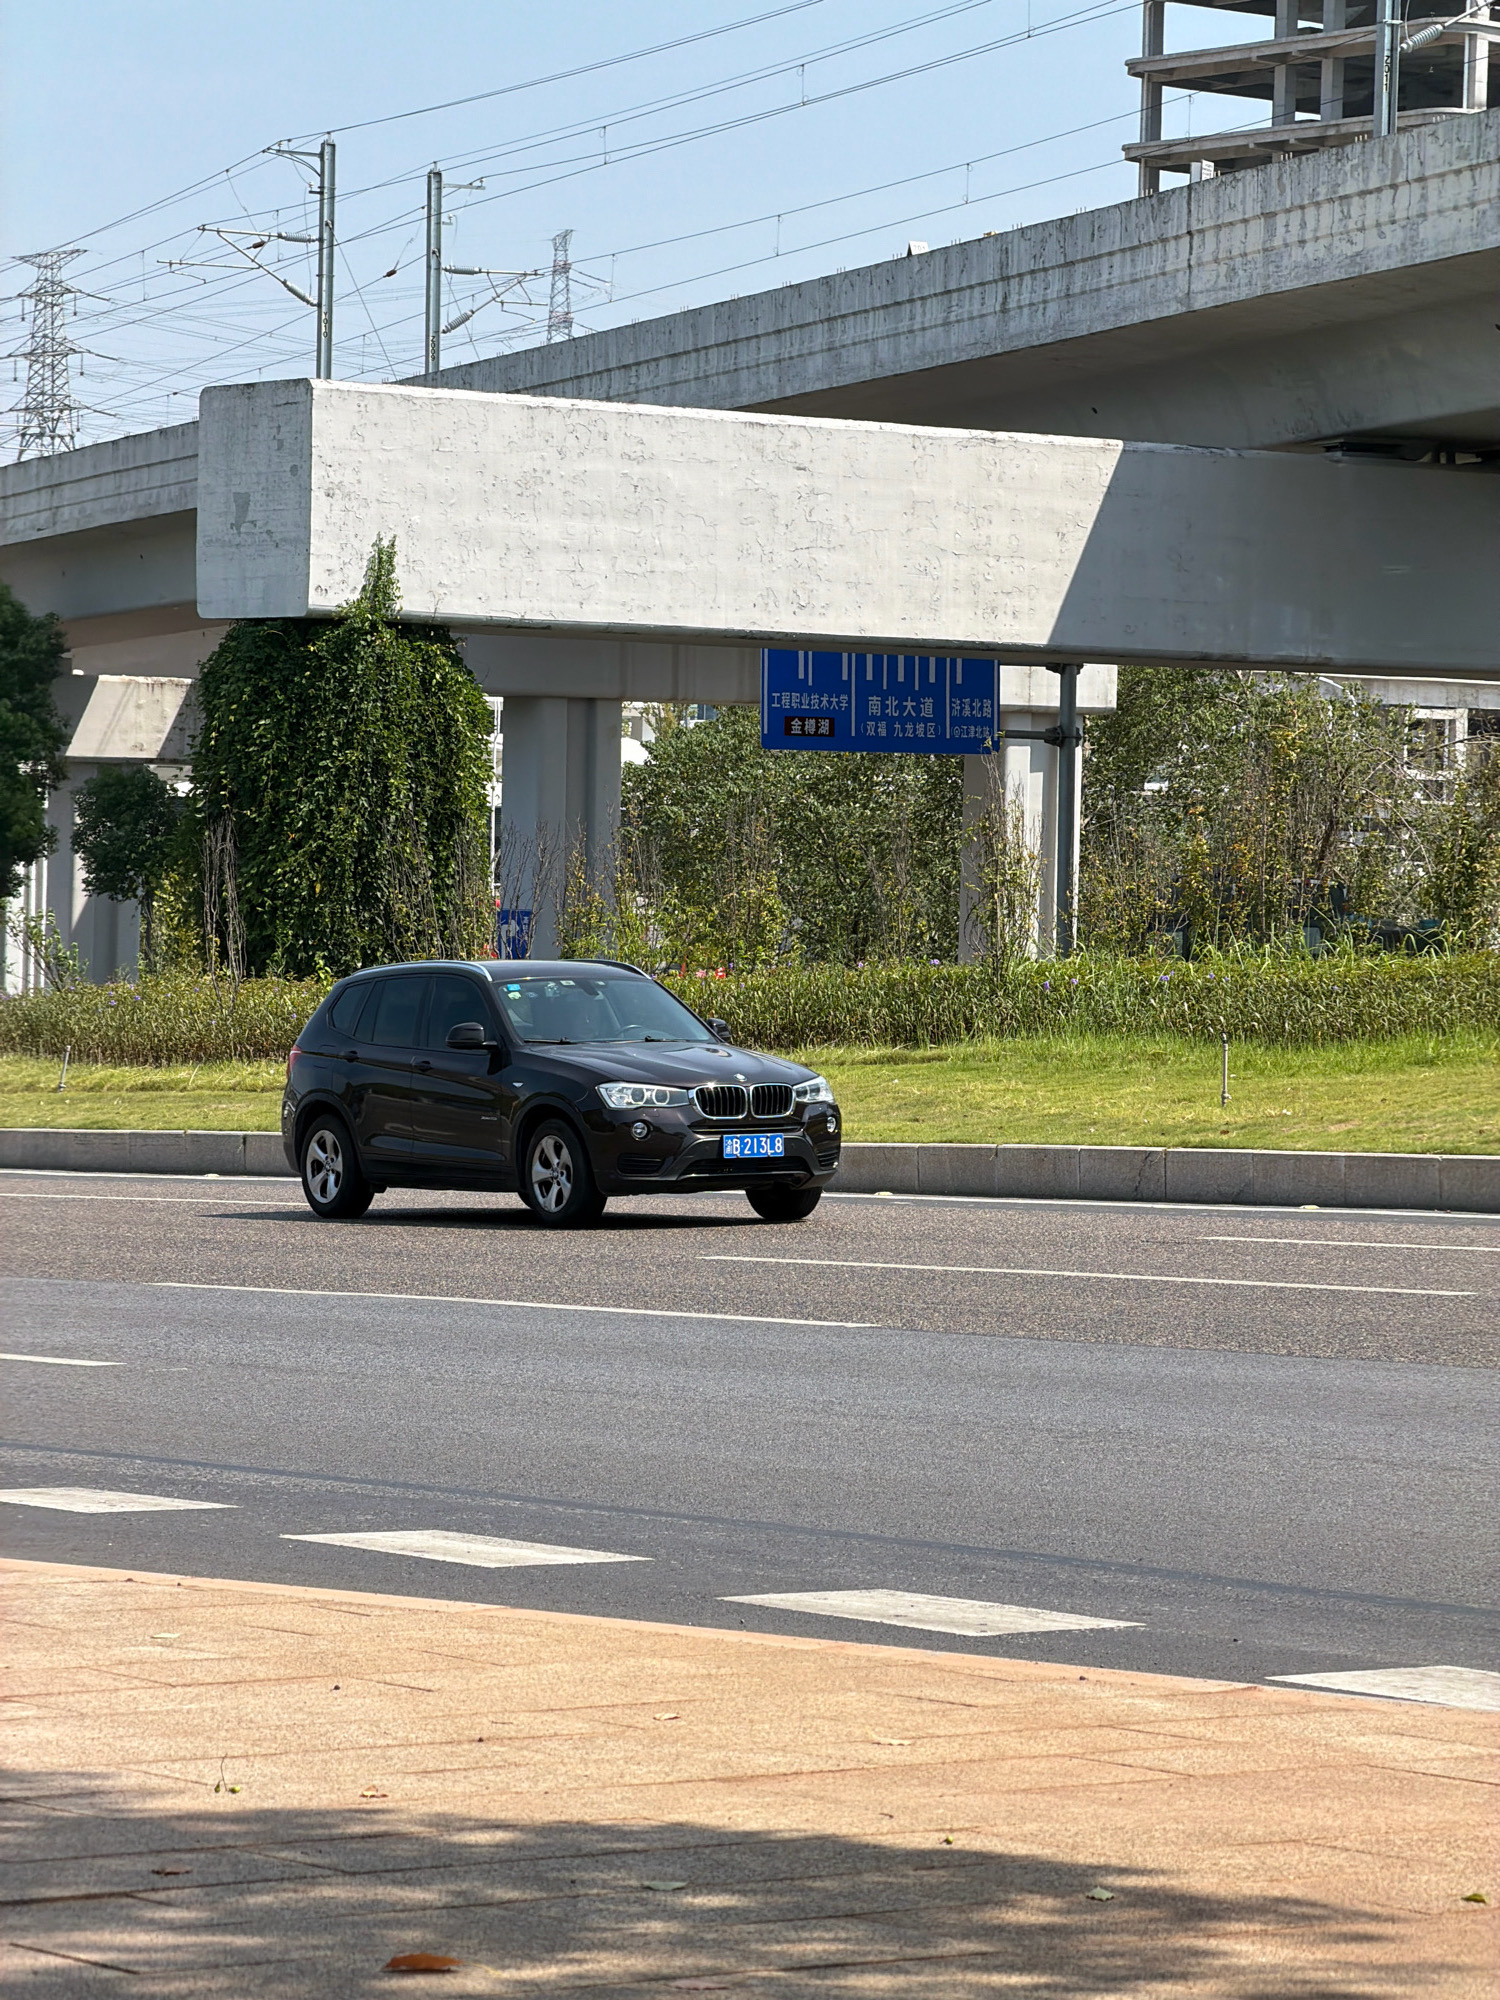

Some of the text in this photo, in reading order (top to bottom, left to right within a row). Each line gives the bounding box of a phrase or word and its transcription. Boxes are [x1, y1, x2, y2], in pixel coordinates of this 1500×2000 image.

[771, 692, 849, 711] 工程职业技术大学
[868, 695, 934, 718] 南北大道
[951, 697, 992, 719] 浒溪北路
[790, 717, 830, 735] 金樽湖
